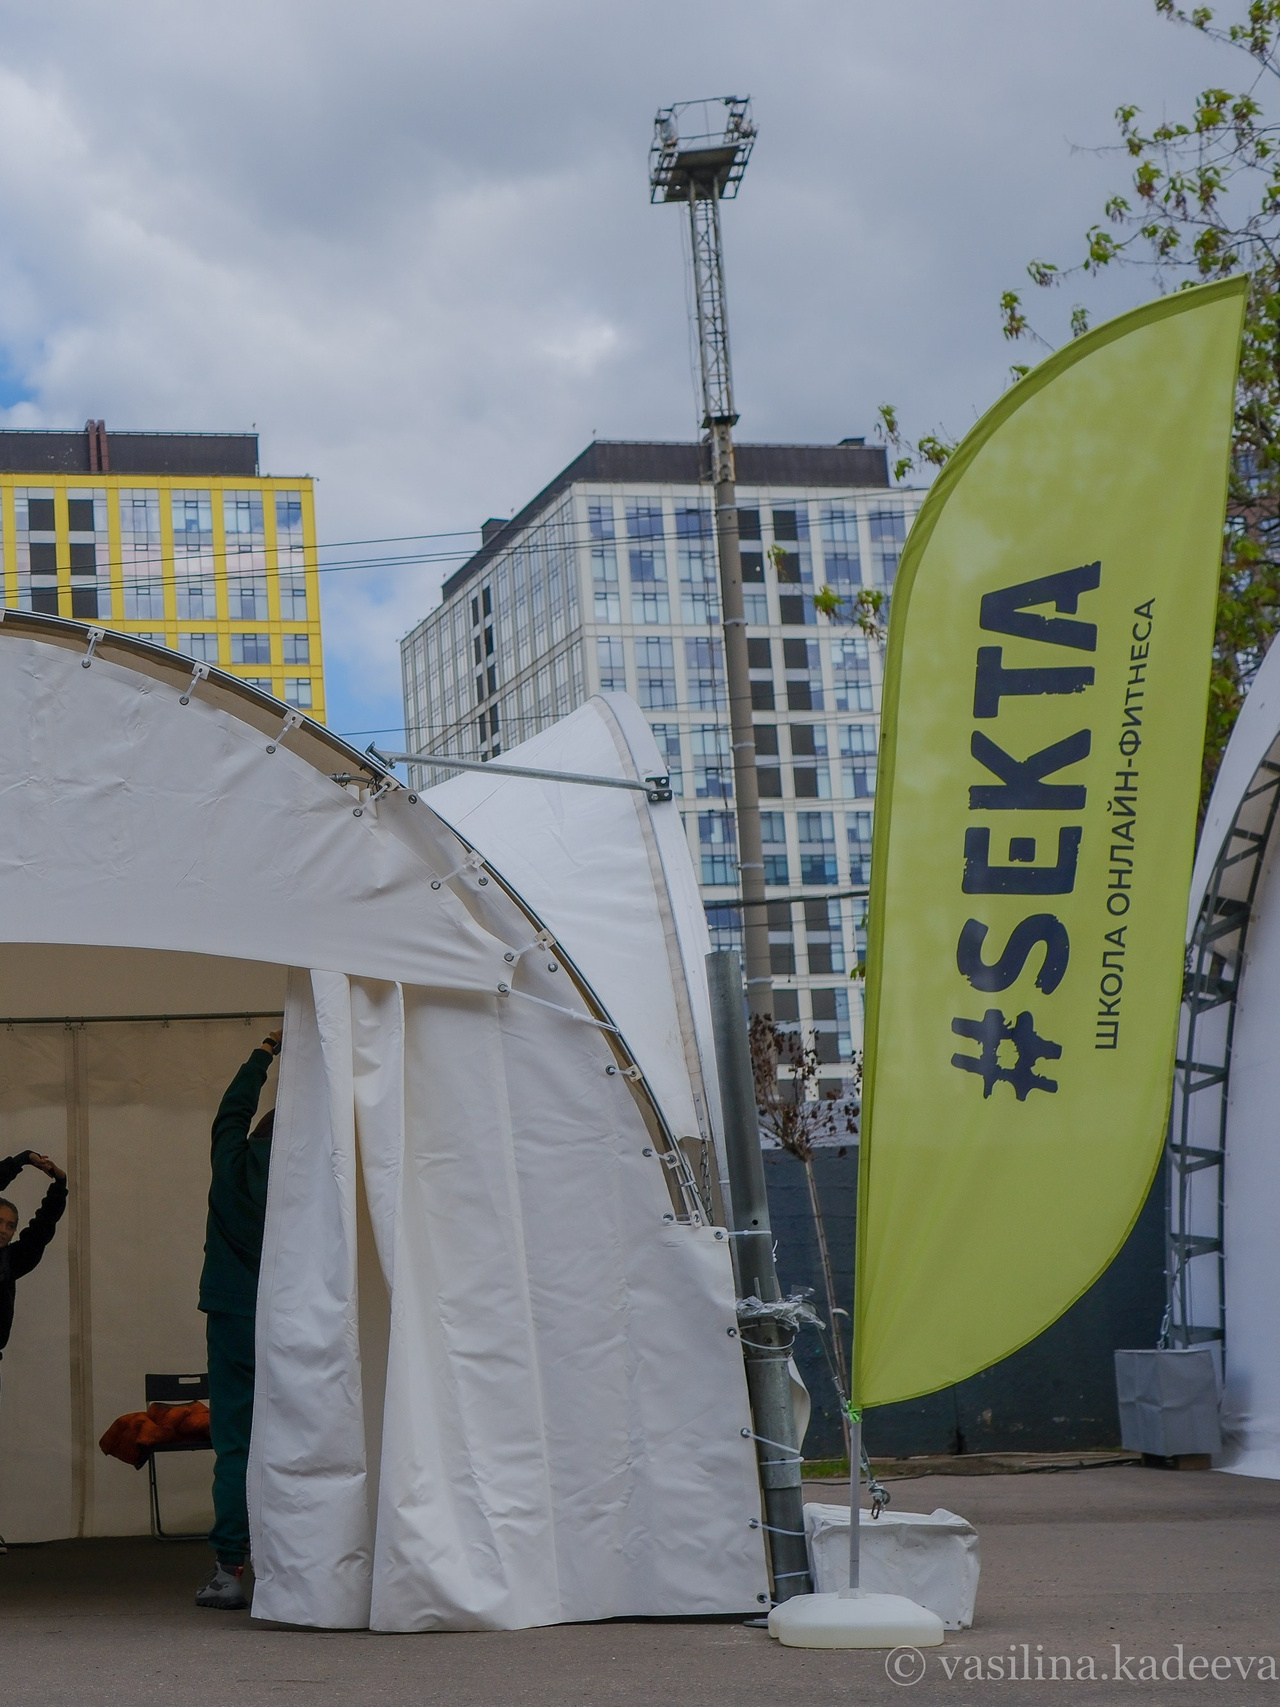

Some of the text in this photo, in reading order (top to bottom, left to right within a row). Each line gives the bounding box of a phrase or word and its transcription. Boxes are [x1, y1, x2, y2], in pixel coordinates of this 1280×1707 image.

[950, 559, 1103, 1103] #SEKTA
[1094, 596, 1157, 1050] ШКОЛА ОНЛАЙН-ФИТНЕСА
